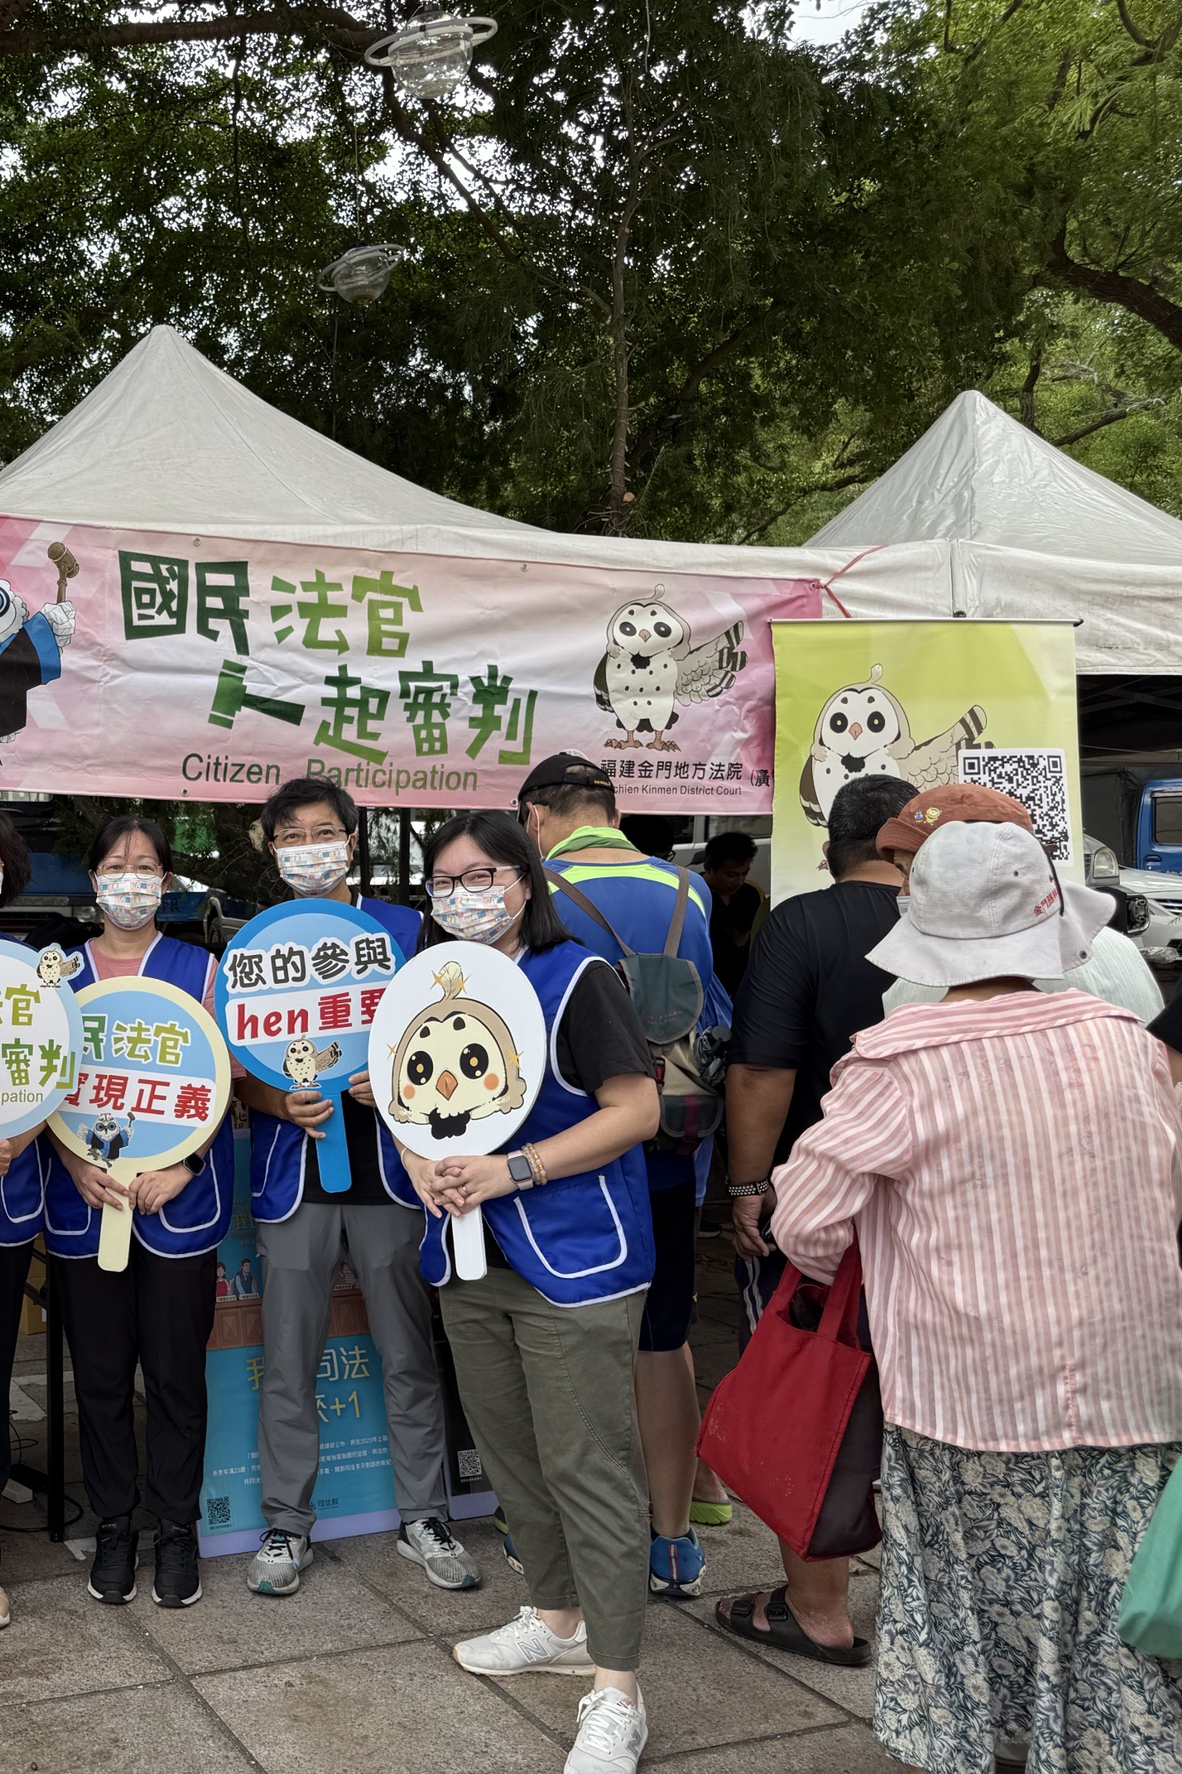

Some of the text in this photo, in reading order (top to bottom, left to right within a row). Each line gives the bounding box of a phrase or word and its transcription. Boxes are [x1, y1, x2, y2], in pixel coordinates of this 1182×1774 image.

[118, 550, 423, 657] 國民法官
[182, 753, 478, 794] Citizen Participation
[600, 759, 743, 781] 福建金門地方法院
[615, 785, 742, 795] chien Kinmen District Court
[228, 937, 391, 989] 您的參與
[82, 1016, 189, 1065] 民法官
